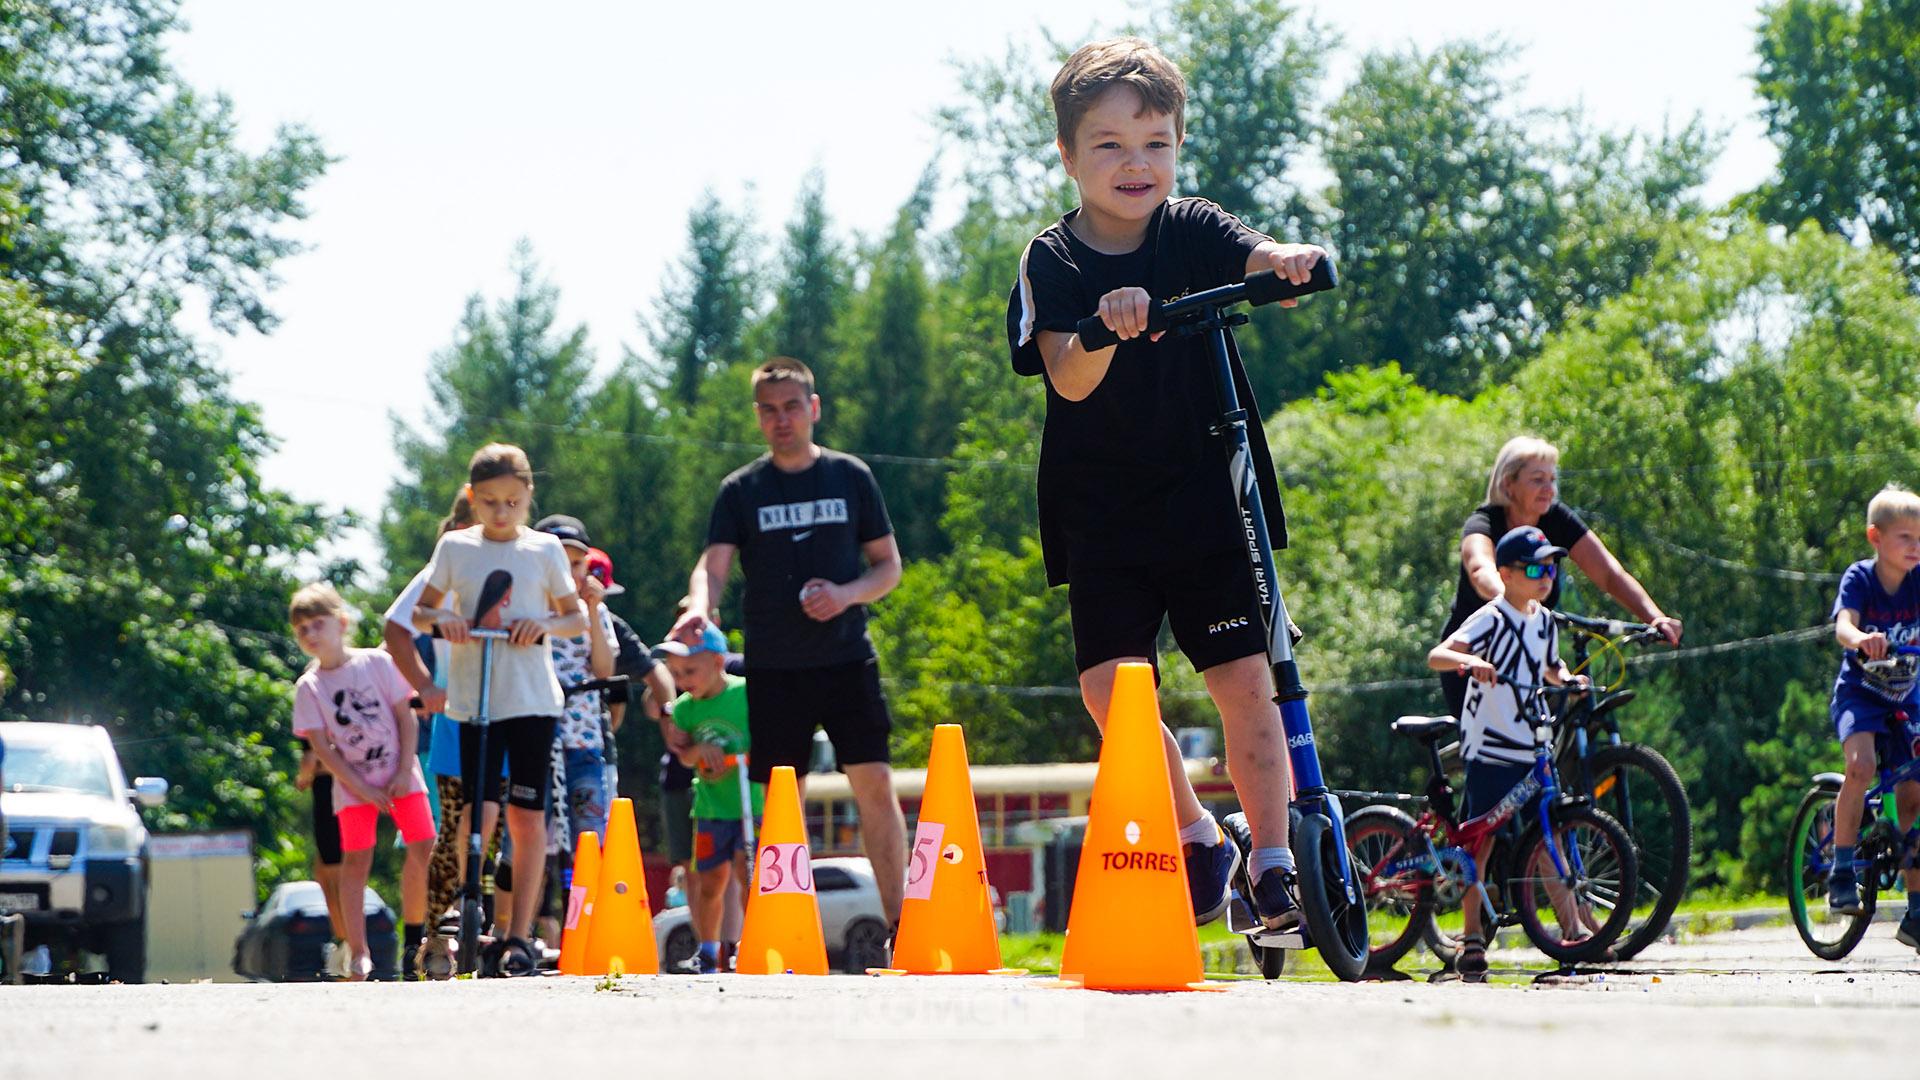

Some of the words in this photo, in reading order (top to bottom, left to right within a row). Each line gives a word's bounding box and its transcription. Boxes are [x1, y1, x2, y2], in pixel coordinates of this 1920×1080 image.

[762, 505, 801, 525] NIKE
[814, 501, 845, 518] AIR
[1241, 507, 1262, 563] SPORT
[1254, 567, 1271, 605] KARI
[760, 845, 811, 892] 30
[908, 837, 935, 885] 5
[1102, 851, 1178, 873] TORRES
